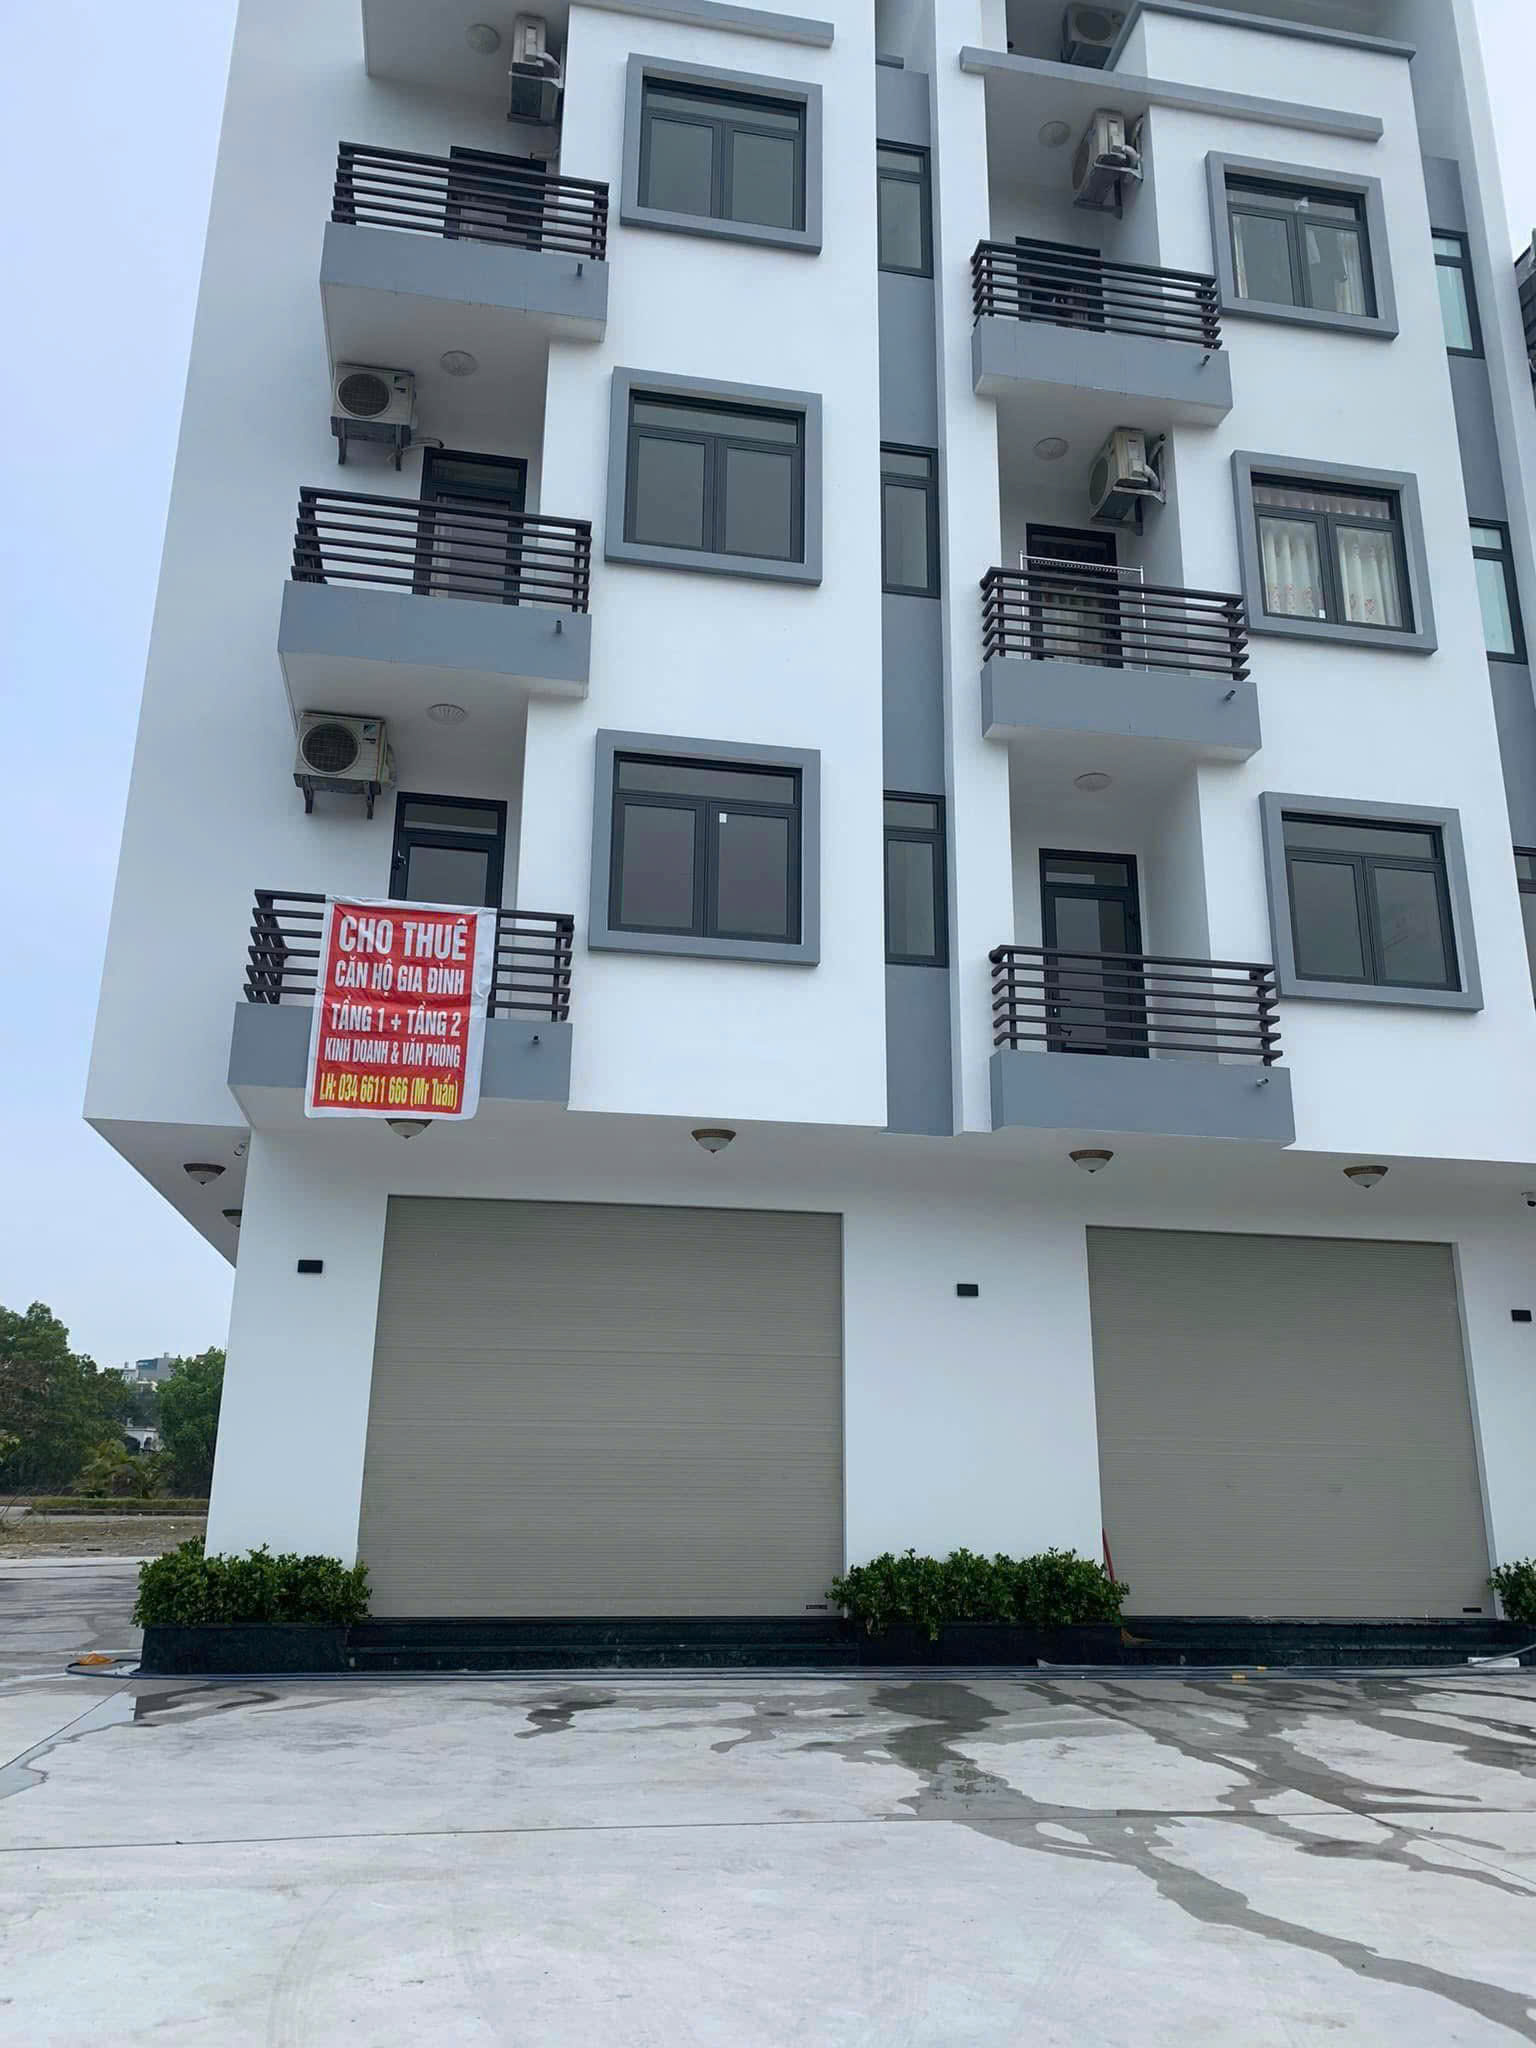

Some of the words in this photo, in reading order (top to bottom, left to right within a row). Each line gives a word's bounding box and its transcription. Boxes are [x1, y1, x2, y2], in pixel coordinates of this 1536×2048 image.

[339, 916, 393, 954] CHO
[402, 919, 467, 960] THUÊ
[335, 956, 368, 989] CĂN
[371, 960, 393, 996] HỘ
[397, 966, 422, 992] GIA
[427, 962, 464, 995] ĐÌNH
[331, 996, 373, 1032] TẦNG
[378, 1008, 385, 1032] 1
[391, 1015, 401, 1030] +
[407, 1001, 446, 1036] TẦNG
[450, 1014, 461, 1036] 2
[324, 1038, 350, 1061] KINH
[352, 1040, 388, 1064] DOANH
[391, 1044, 398, 1063] &
[402, 1039, 423, 1065] VĂN
[425, 1040, 460, 1067] PHÒNG
[320, 1073, 336, 1101] LH:
[339, 1075, 357, 1101] 034
[360, 1074, 385, 1102] 6611
[388, 1077, 408, 1103] 666
[411, 1077, 428, 1107] (Mr
[431, 1073, 458, 1110] Tuấn)
